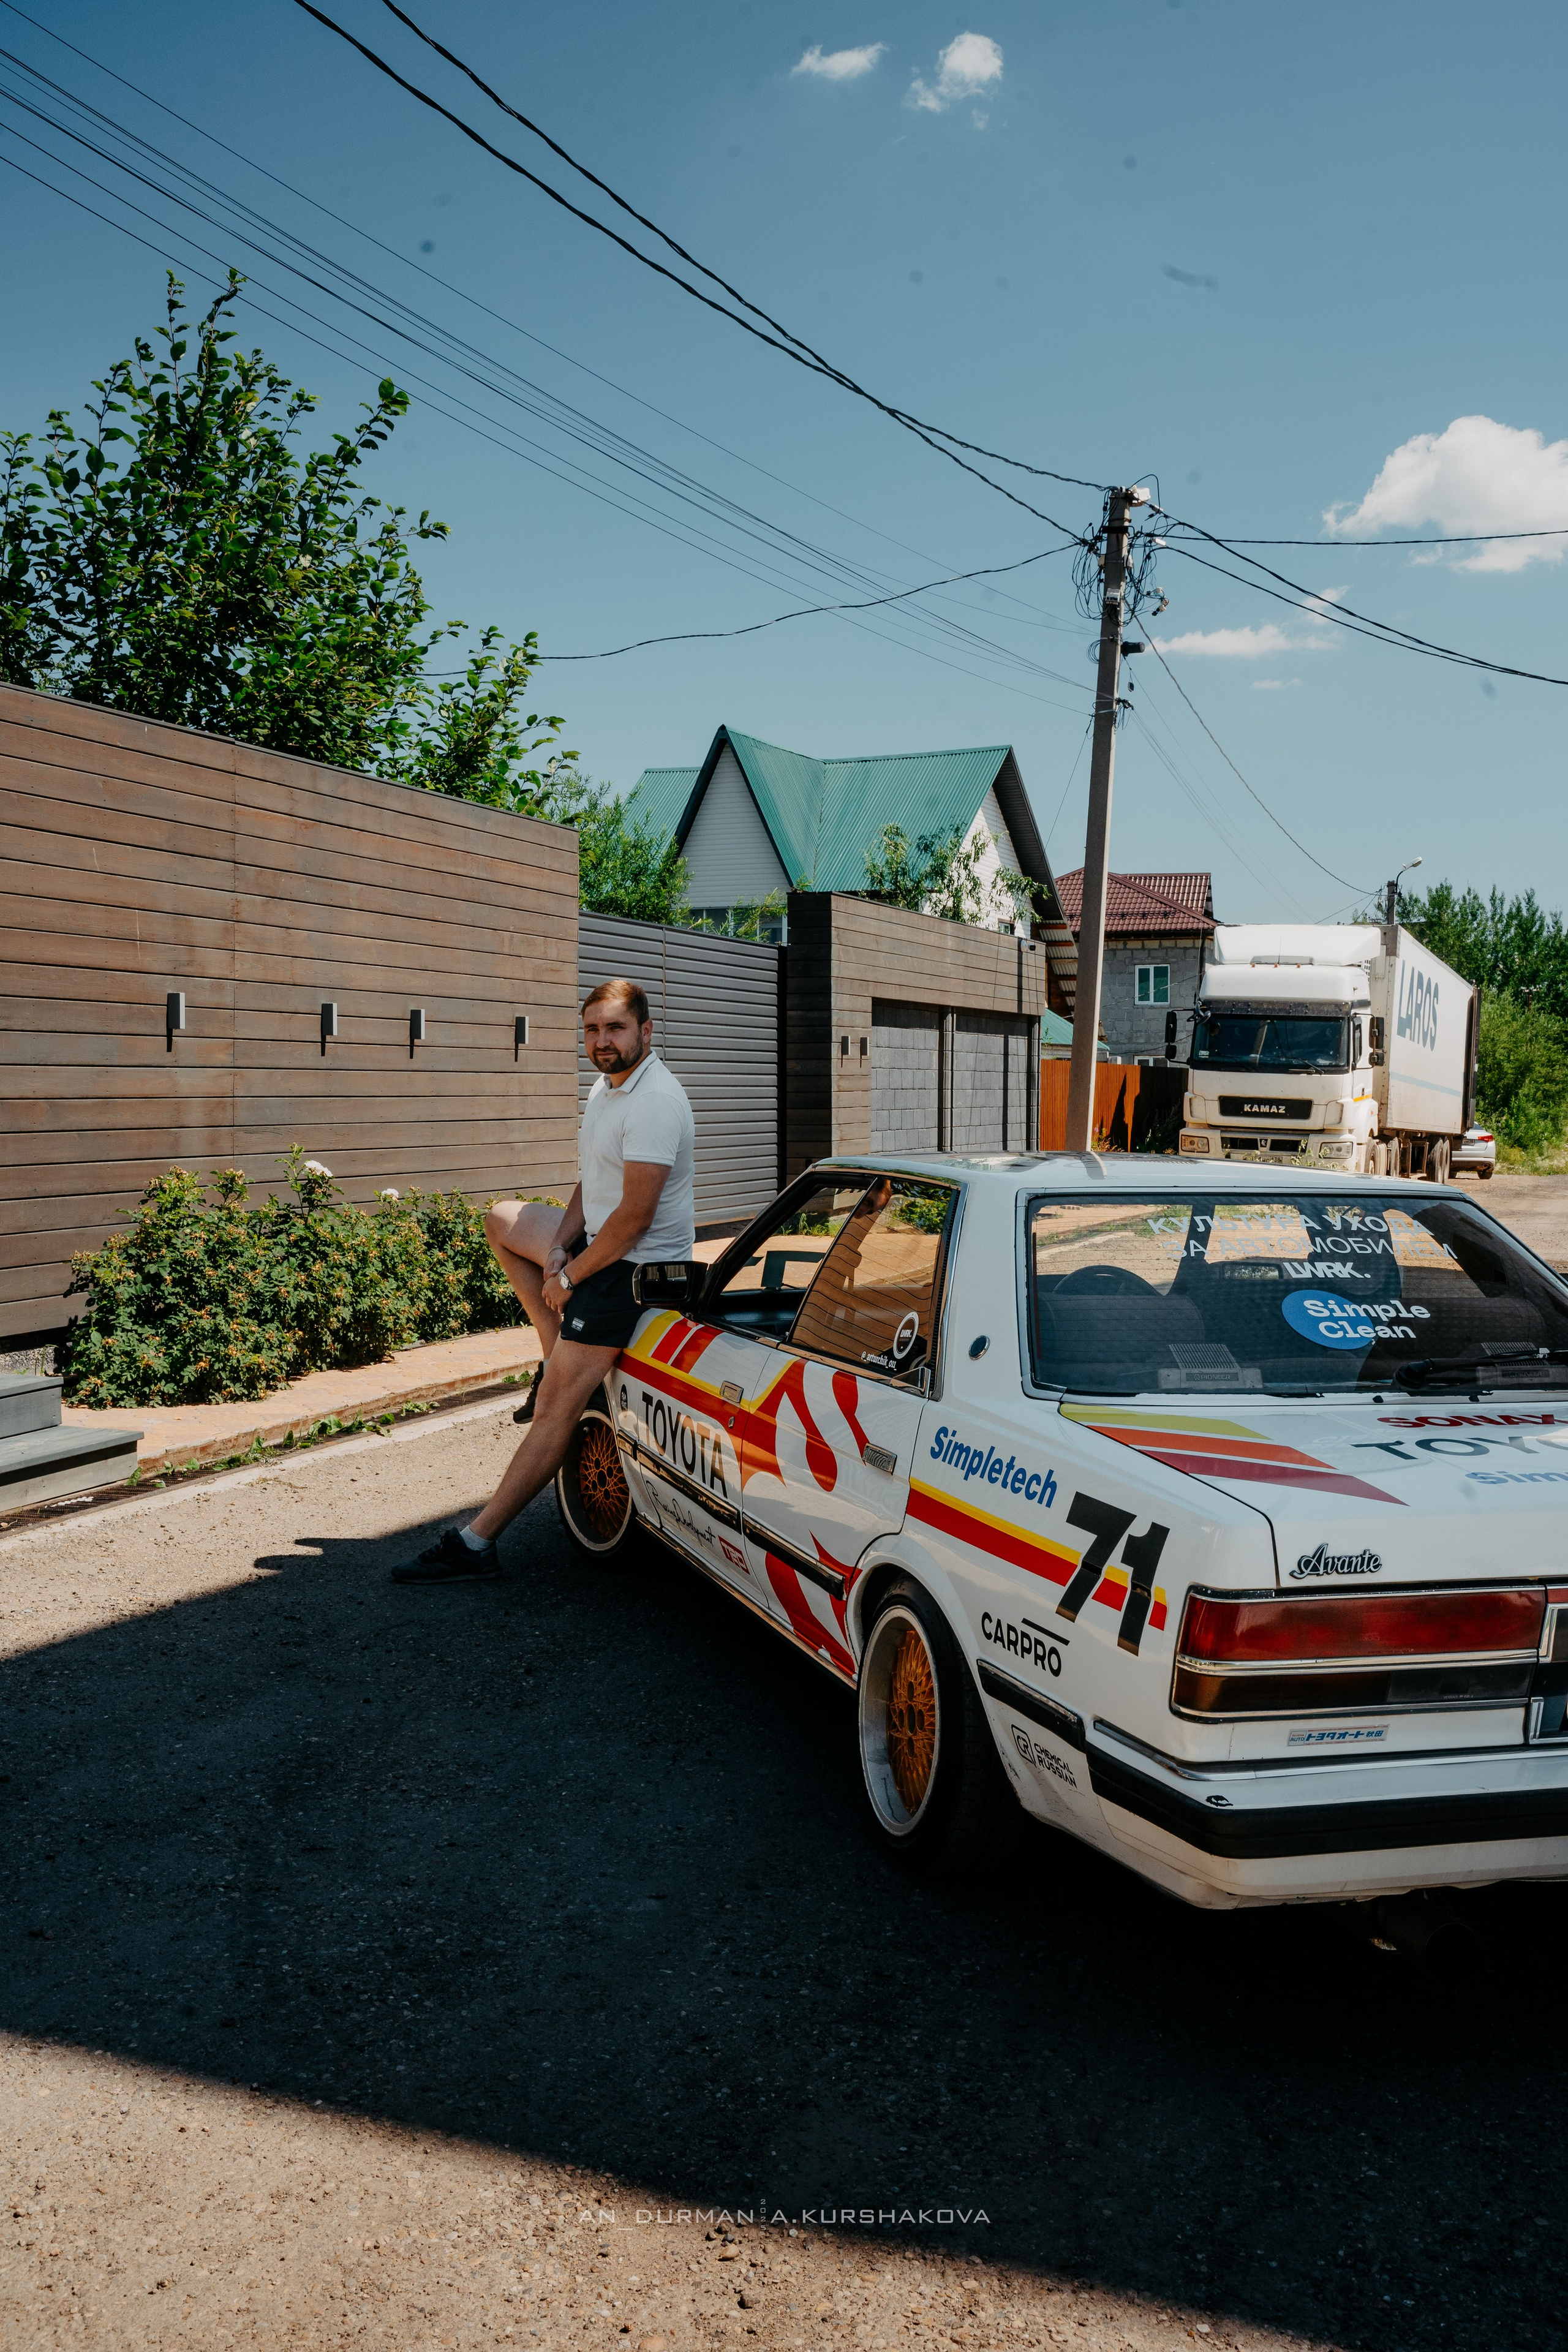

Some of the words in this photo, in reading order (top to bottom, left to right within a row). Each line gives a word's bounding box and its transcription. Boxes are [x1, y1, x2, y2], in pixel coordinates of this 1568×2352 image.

[1397, 960, 1439, 1052] LAROS
[1244, 1104, 1285, 1113] KAMAZ
[1147, 1215, 1322, 1235] КУЛЬТУРА
[1322, 1214, 1434, 1236] УХОДА
[1163, 1240, 1211, 1258] ЗА
[1220, 1237, 1458, 1259] АВТОМОБИЛЕМ
[1303, 1300, 1431, 1321] Simple
[1318, 1321, 1417, 1338] Clean
[642, 1390, 728, 1499] TOYOTA
[930, 1426, 1057, 1509] Simpletech
[1465, 1471, 1568, 1484] Sim
[1055, 1491, 1170, 1657] 71
[1289, 1543, 1382, 1579] Avante
[981, 1611, 1061, 1677] CARPRO
[1034, 1743, 1074, 1776] CHEMICAL
[1037, 1754, 1077, 1789] RUSSIAN
